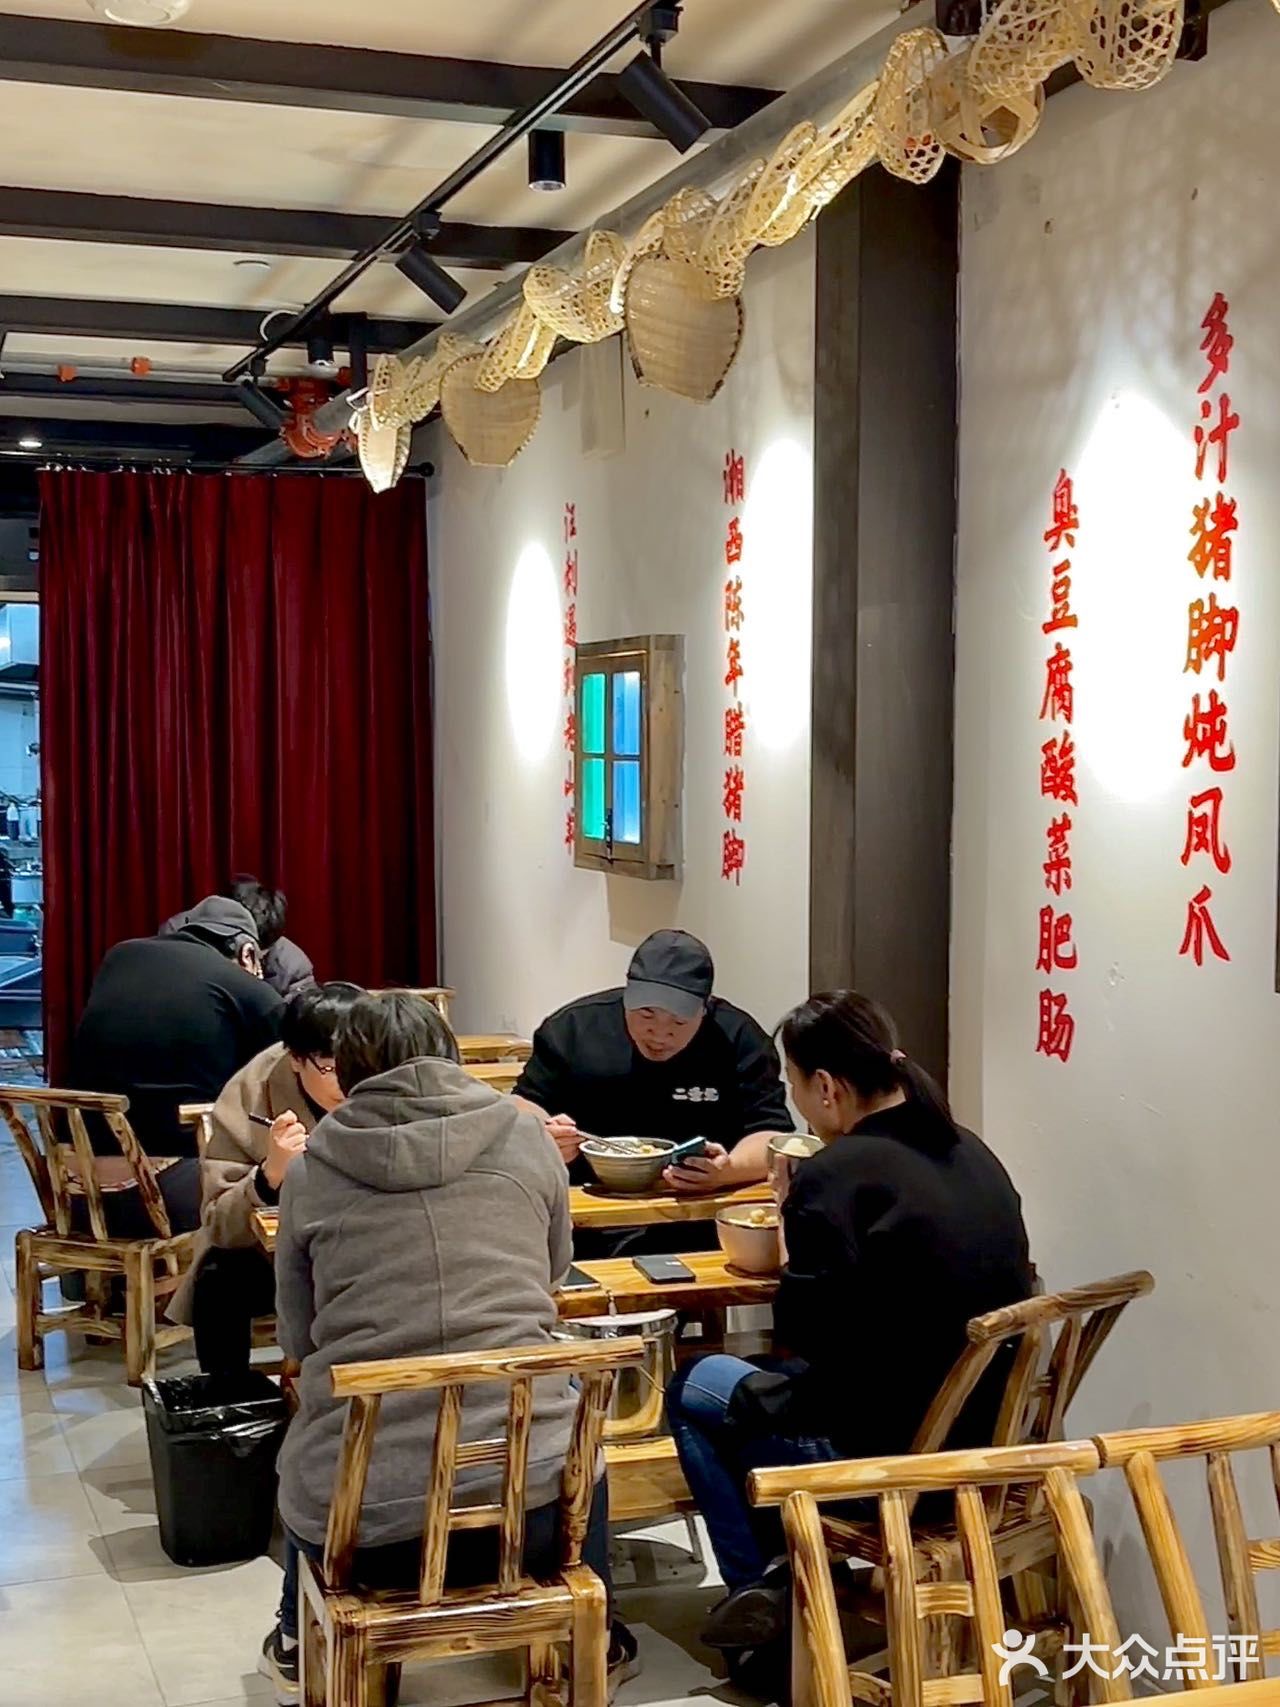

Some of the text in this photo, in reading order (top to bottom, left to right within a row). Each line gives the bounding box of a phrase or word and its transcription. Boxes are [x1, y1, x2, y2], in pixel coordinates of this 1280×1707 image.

[1036, 468, 1079, 1064] 臭豆腐酸菜肥肠
[1181, 292, 1242, 968] 多汁猪脚炖凤爪
